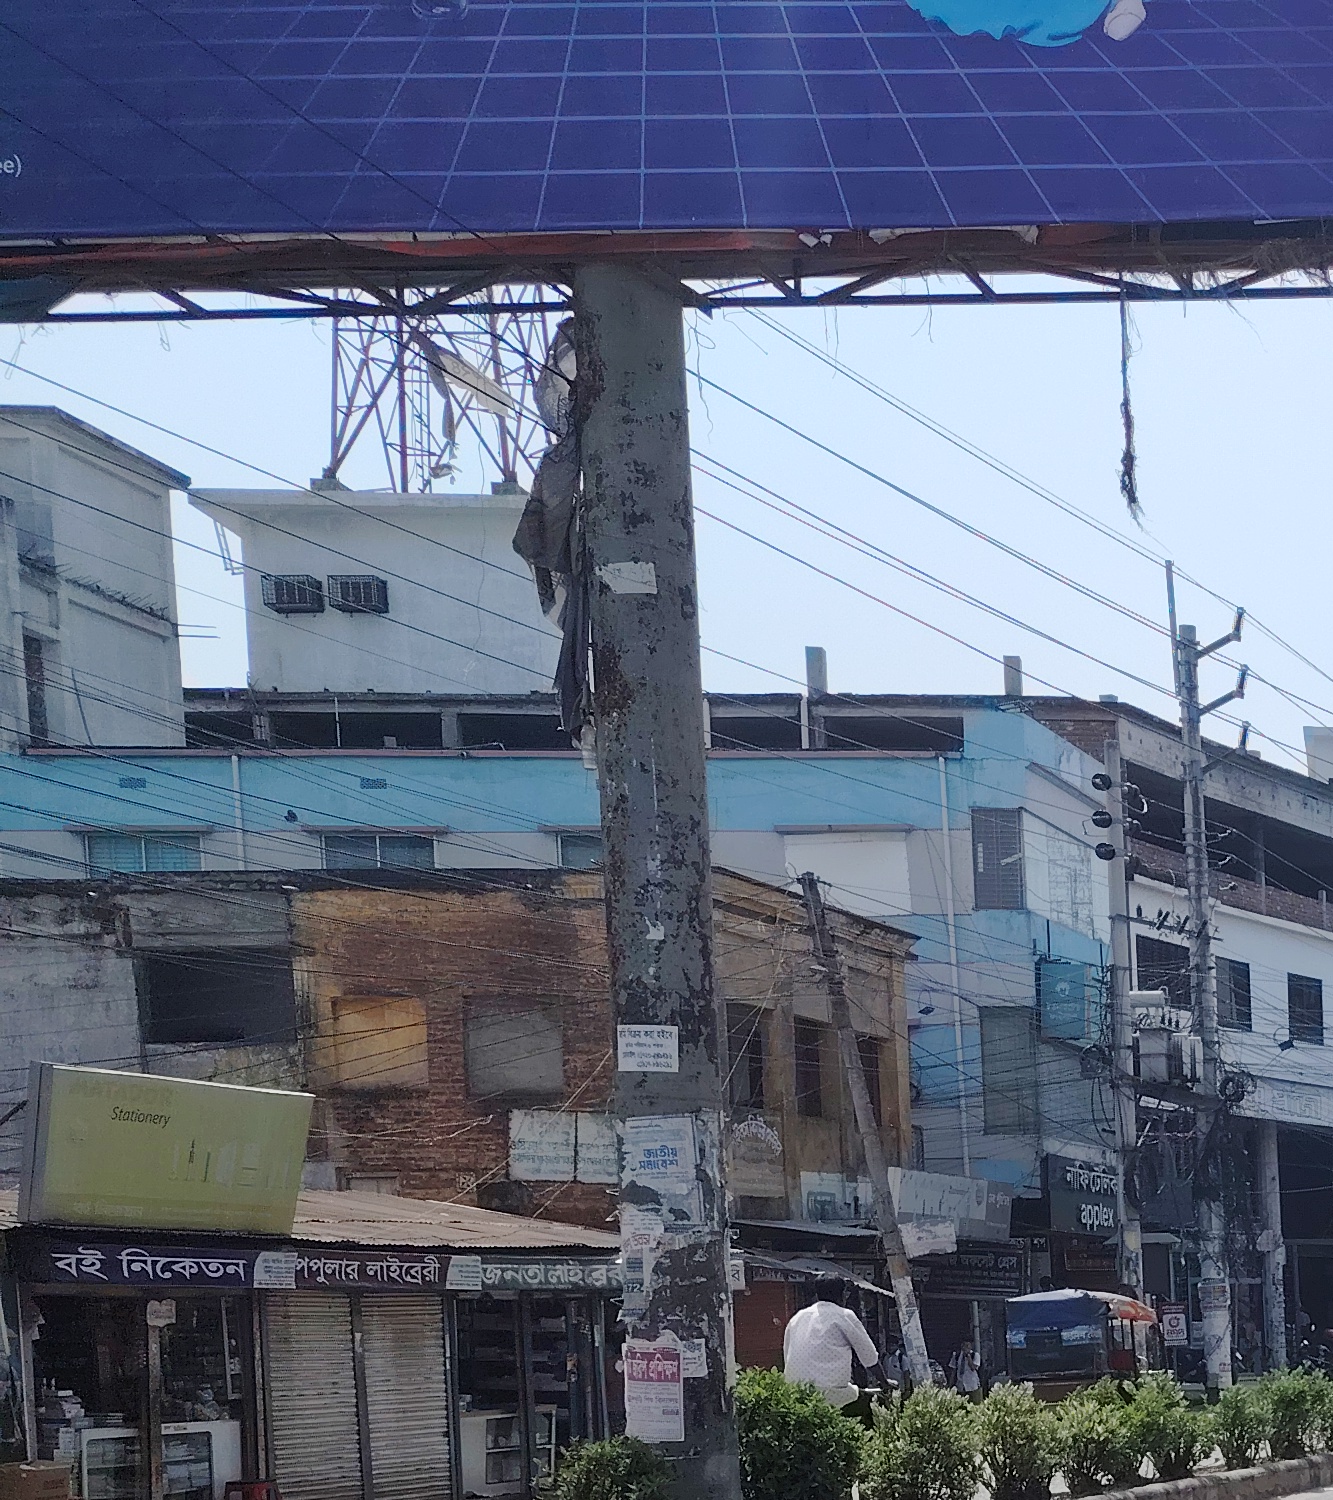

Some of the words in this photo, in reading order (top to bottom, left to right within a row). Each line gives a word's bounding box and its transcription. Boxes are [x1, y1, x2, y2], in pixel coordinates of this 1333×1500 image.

[0, 153, 22, 178] e)
[110, 1105, 171, 1129] Stationery
[642, 1145, 678, 1159] জাতীয়
[1080, 1203, 1114, 1231] applex
[51, 1246, 109, 1281] বই
[116, 1248, 248, 1282] নিকেতন
[295, 1256, 360, 1286] পপুলার
[366, 1255, 442, 1286] লাইব্রেরী
[481, 1261, 545, 1285] জনতা
[548, 1259, 622, 1287] লাইব্রের
